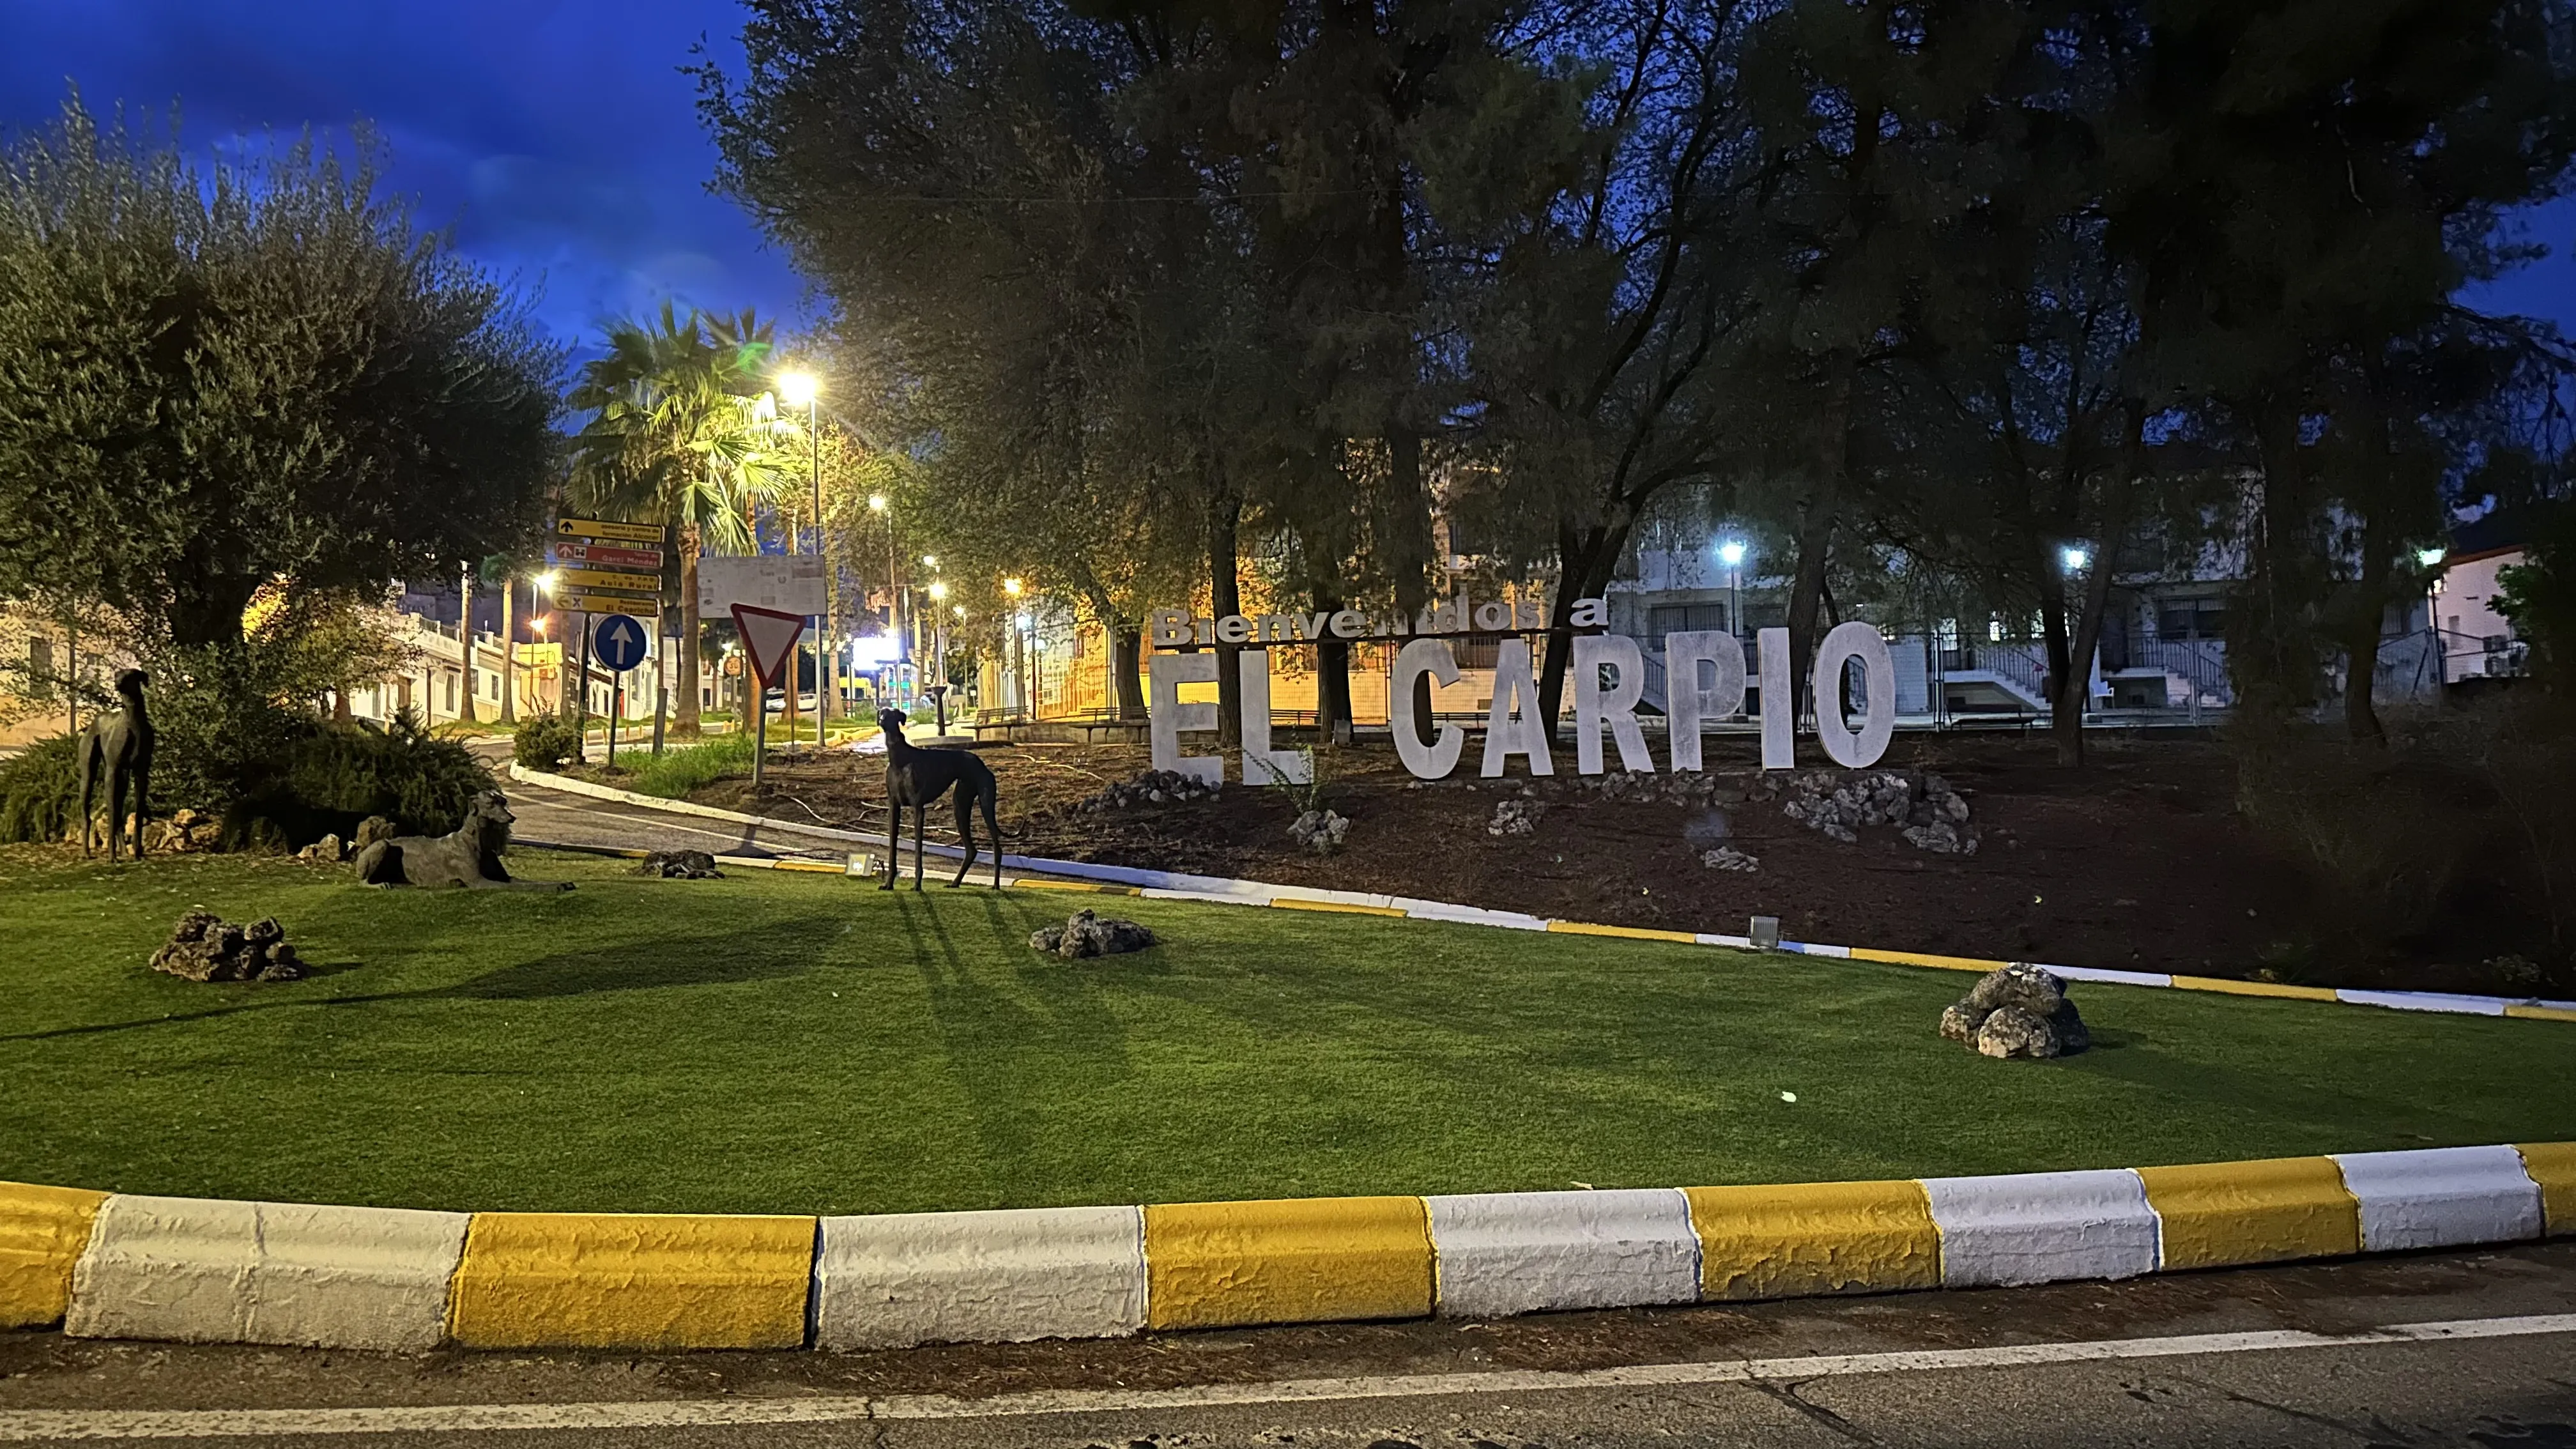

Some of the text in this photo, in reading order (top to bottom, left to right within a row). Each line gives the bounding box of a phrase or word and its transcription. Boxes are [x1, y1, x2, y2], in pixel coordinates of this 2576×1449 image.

[633, 532, 659, 540] Alcocer
[602, 554, 624, 563] Garci
[617, 605, 655, 615] Capricho
[1570, 598, 1609, 627] a
[1150, 621, 1896, 786] EL CARPIO
